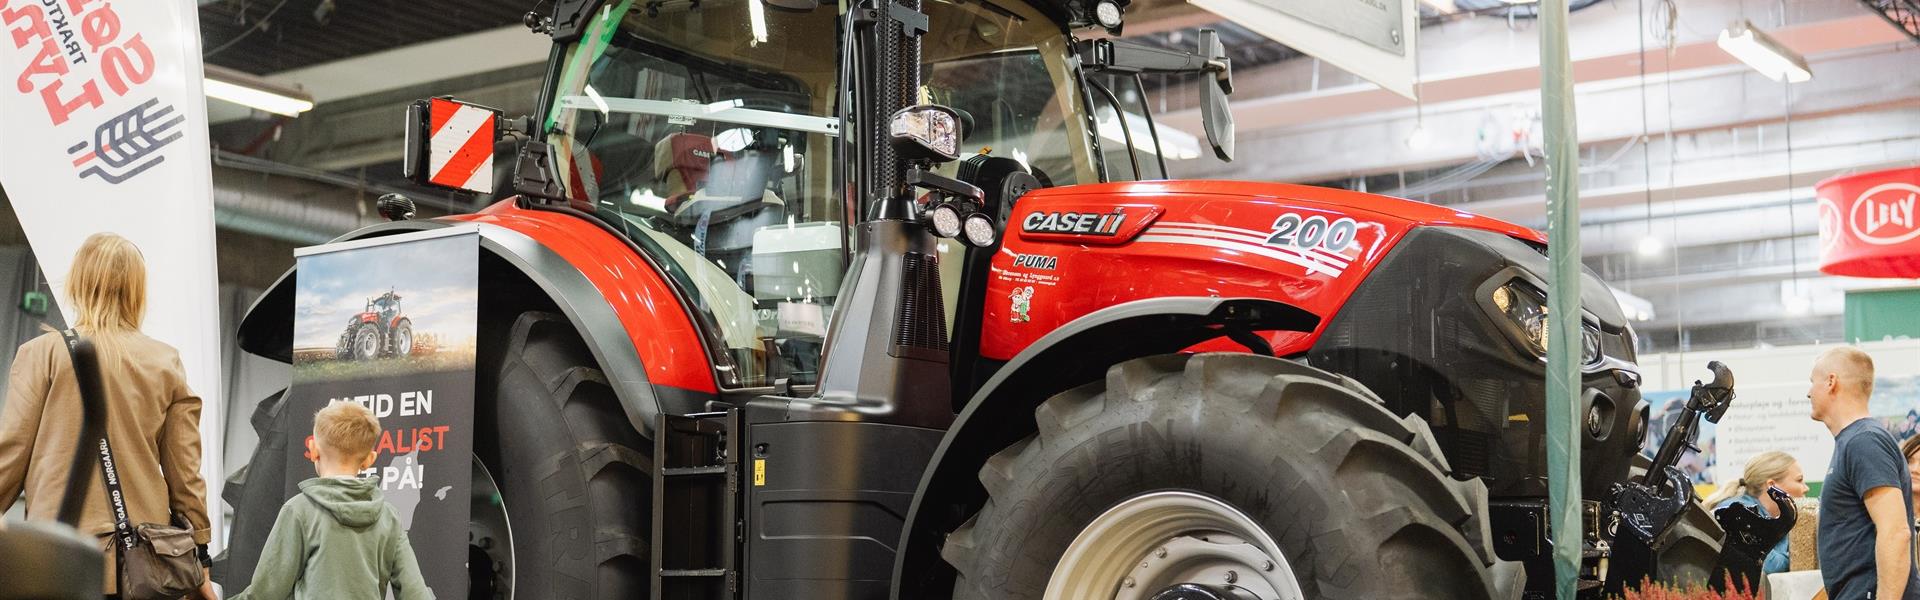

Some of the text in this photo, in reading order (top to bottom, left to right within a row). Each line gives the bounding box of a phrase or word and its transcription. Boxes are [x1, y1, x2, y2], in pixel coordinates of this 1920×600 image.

[1022, 211, 1098, 233] CASE
[1866, 192, 1917, 235] LELY
[1265, 212, 1358, 253] 200
[1013, 253, 1058, 270] PUMA
[400, 390, 433, 417] EN
[382, 456, 424, 491] PÅ!
